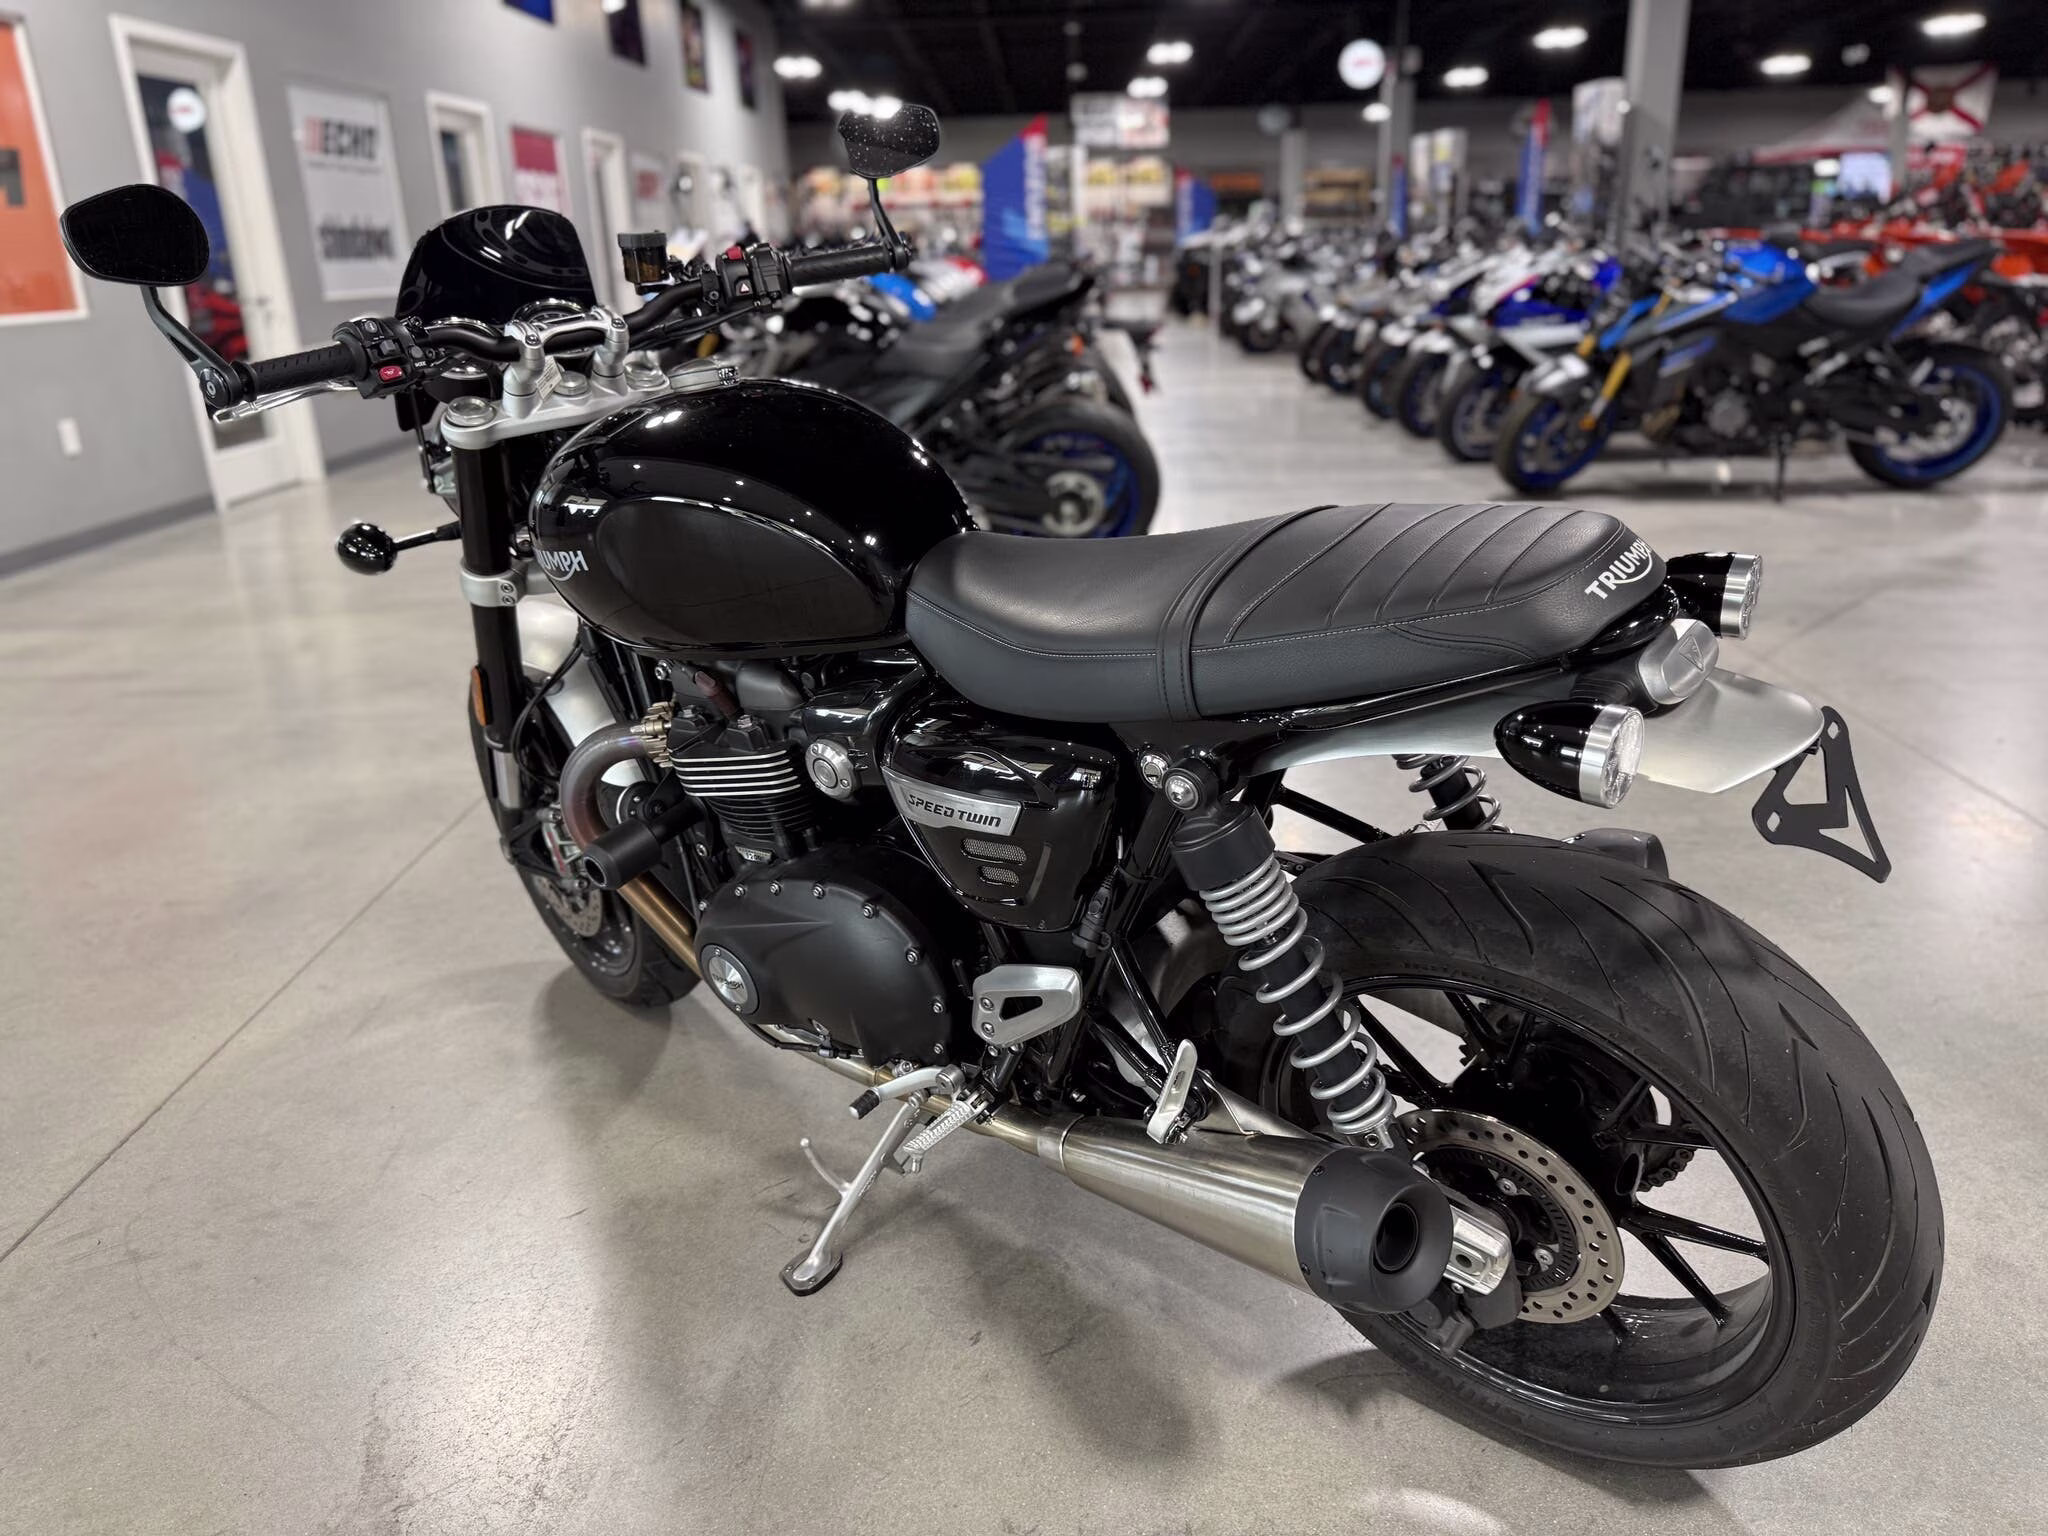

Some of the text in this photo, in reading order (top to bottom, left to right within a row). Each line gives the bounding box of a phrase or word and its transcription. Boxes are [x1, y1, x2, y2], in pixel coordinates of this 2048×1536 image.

[534, 548, 589, 581] IUMPH
[908, 794, 1002, 828] SPEED TWIN
